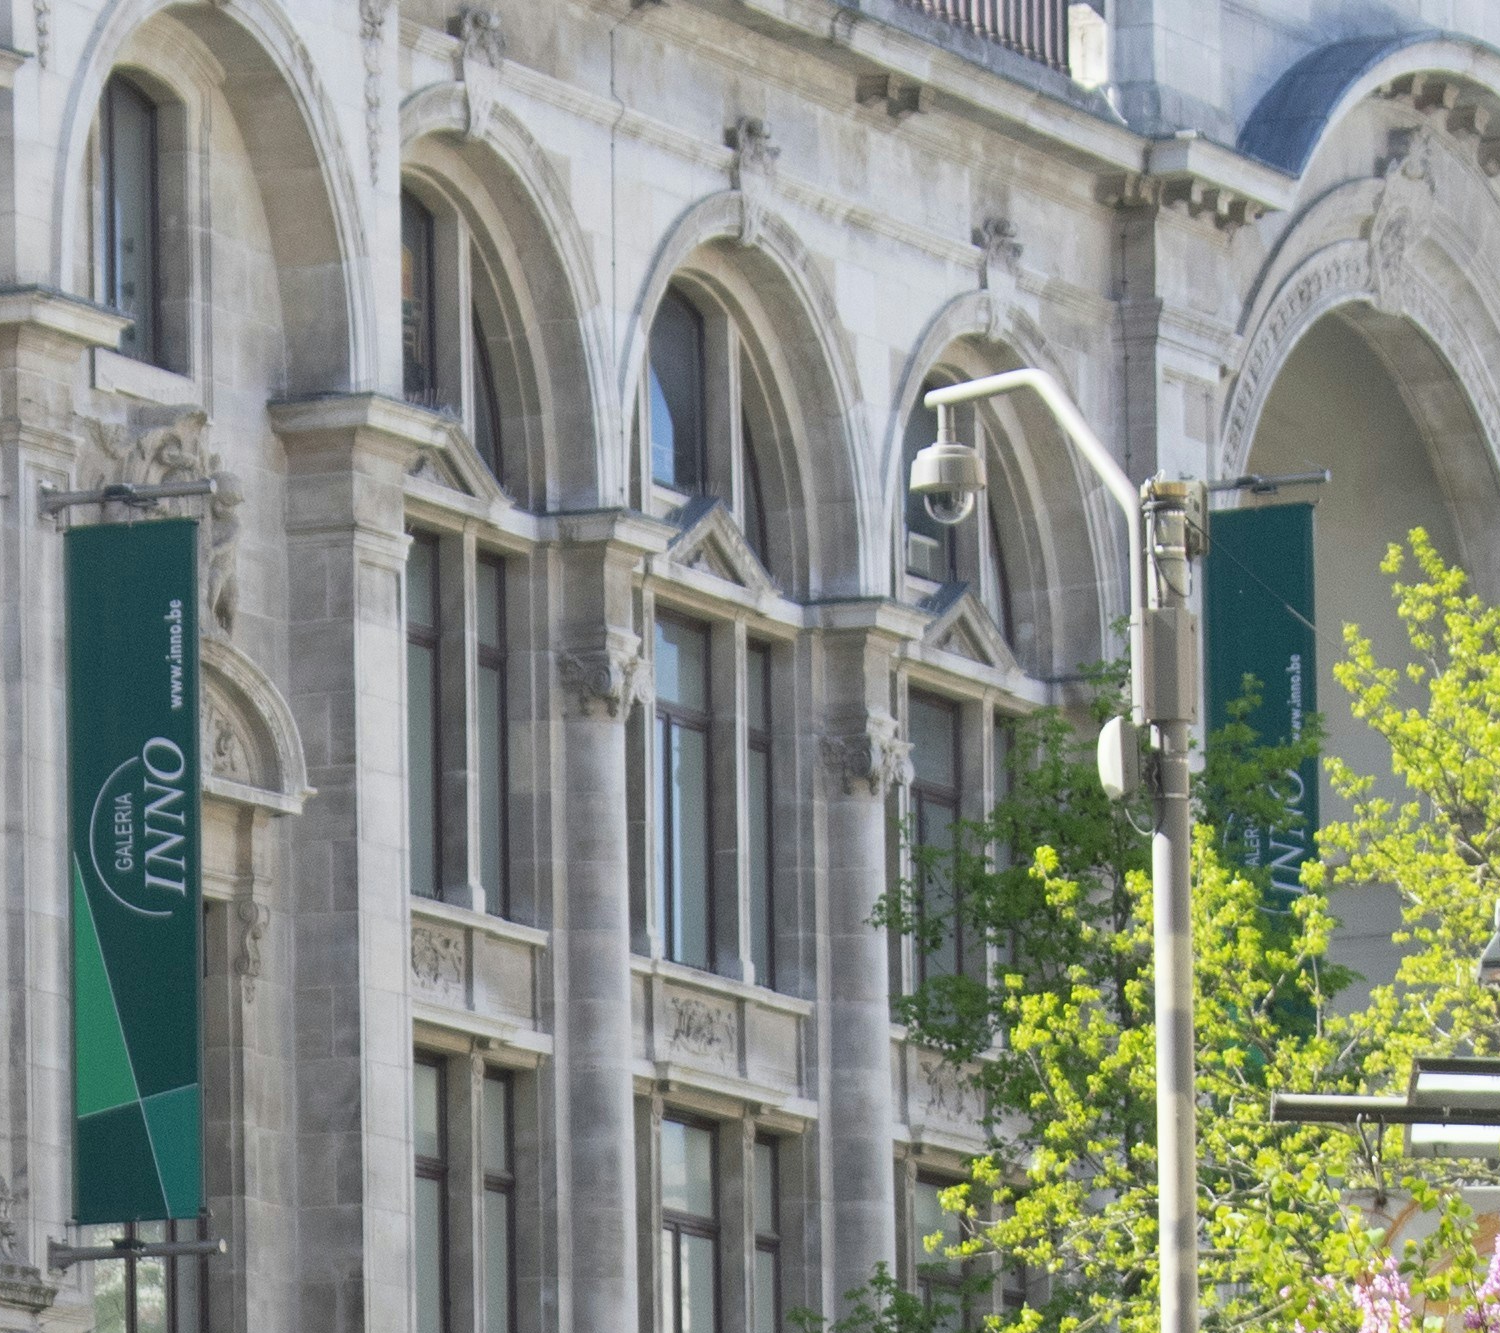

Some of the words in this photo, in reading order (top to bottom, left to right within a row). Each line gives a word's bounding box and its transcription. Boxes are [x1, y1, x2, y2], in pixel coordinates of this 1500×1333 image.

[168, 598, 184, 710] www.inno.be
[114, 791, 133, 873] GALERIA
[141, 736, 187, 897] INNO
